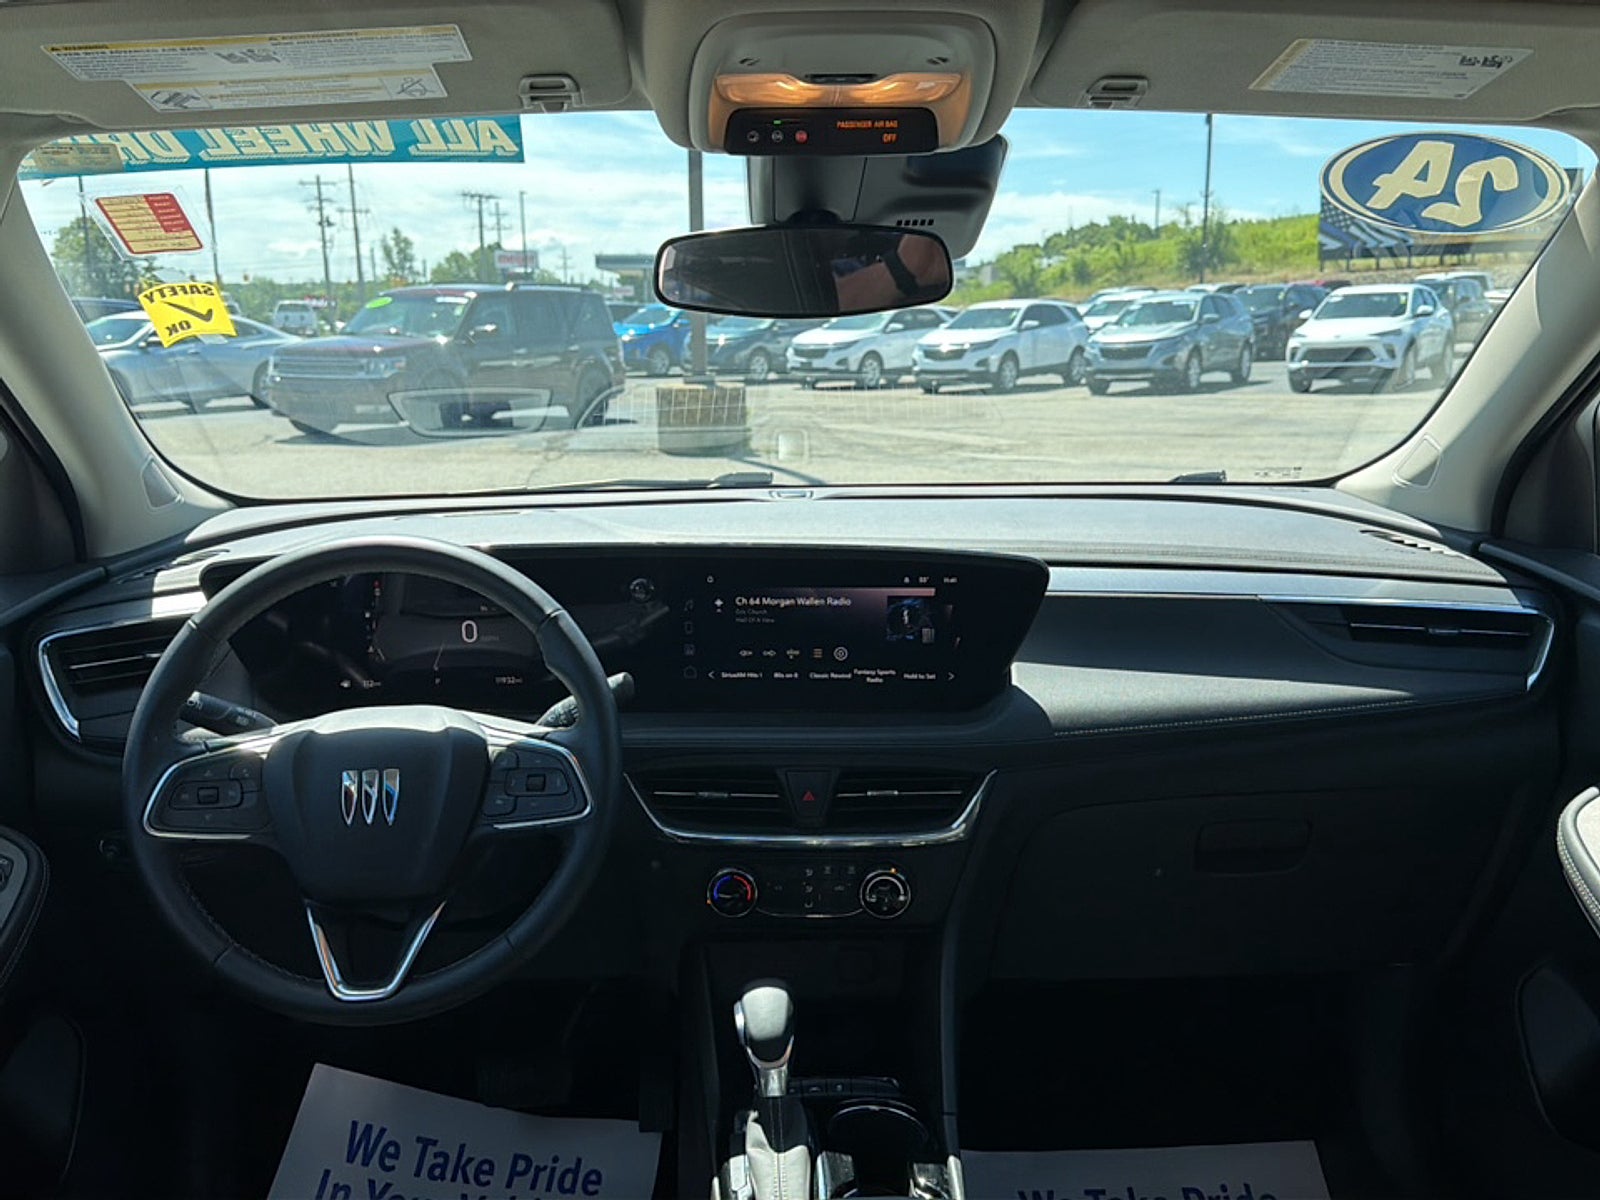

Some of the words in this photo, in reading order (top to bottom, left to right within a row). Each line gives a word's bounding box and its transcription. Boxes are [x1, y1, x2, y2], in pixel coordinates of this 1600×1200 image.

[836, 120, 872, 128] PASSENGER
[874, 120, 884, 128] AIR
[885, 120, 899, 128] BAG
[882, 133, 897, 142] OFF
[735, 596, 747, 606] Ch
[749, 596, 760, 606] 64
[761, 596, 795, 608] Morgan
[797, 596, 825, 606] Wallen
[826, 596, 851, 606] Radio
[461, 620, 479, 643] 0
[345, 1120, 400, 1173] We
[413, 1136, 496, 1187] Take
[505, 1153, 603, 1197] Pride
